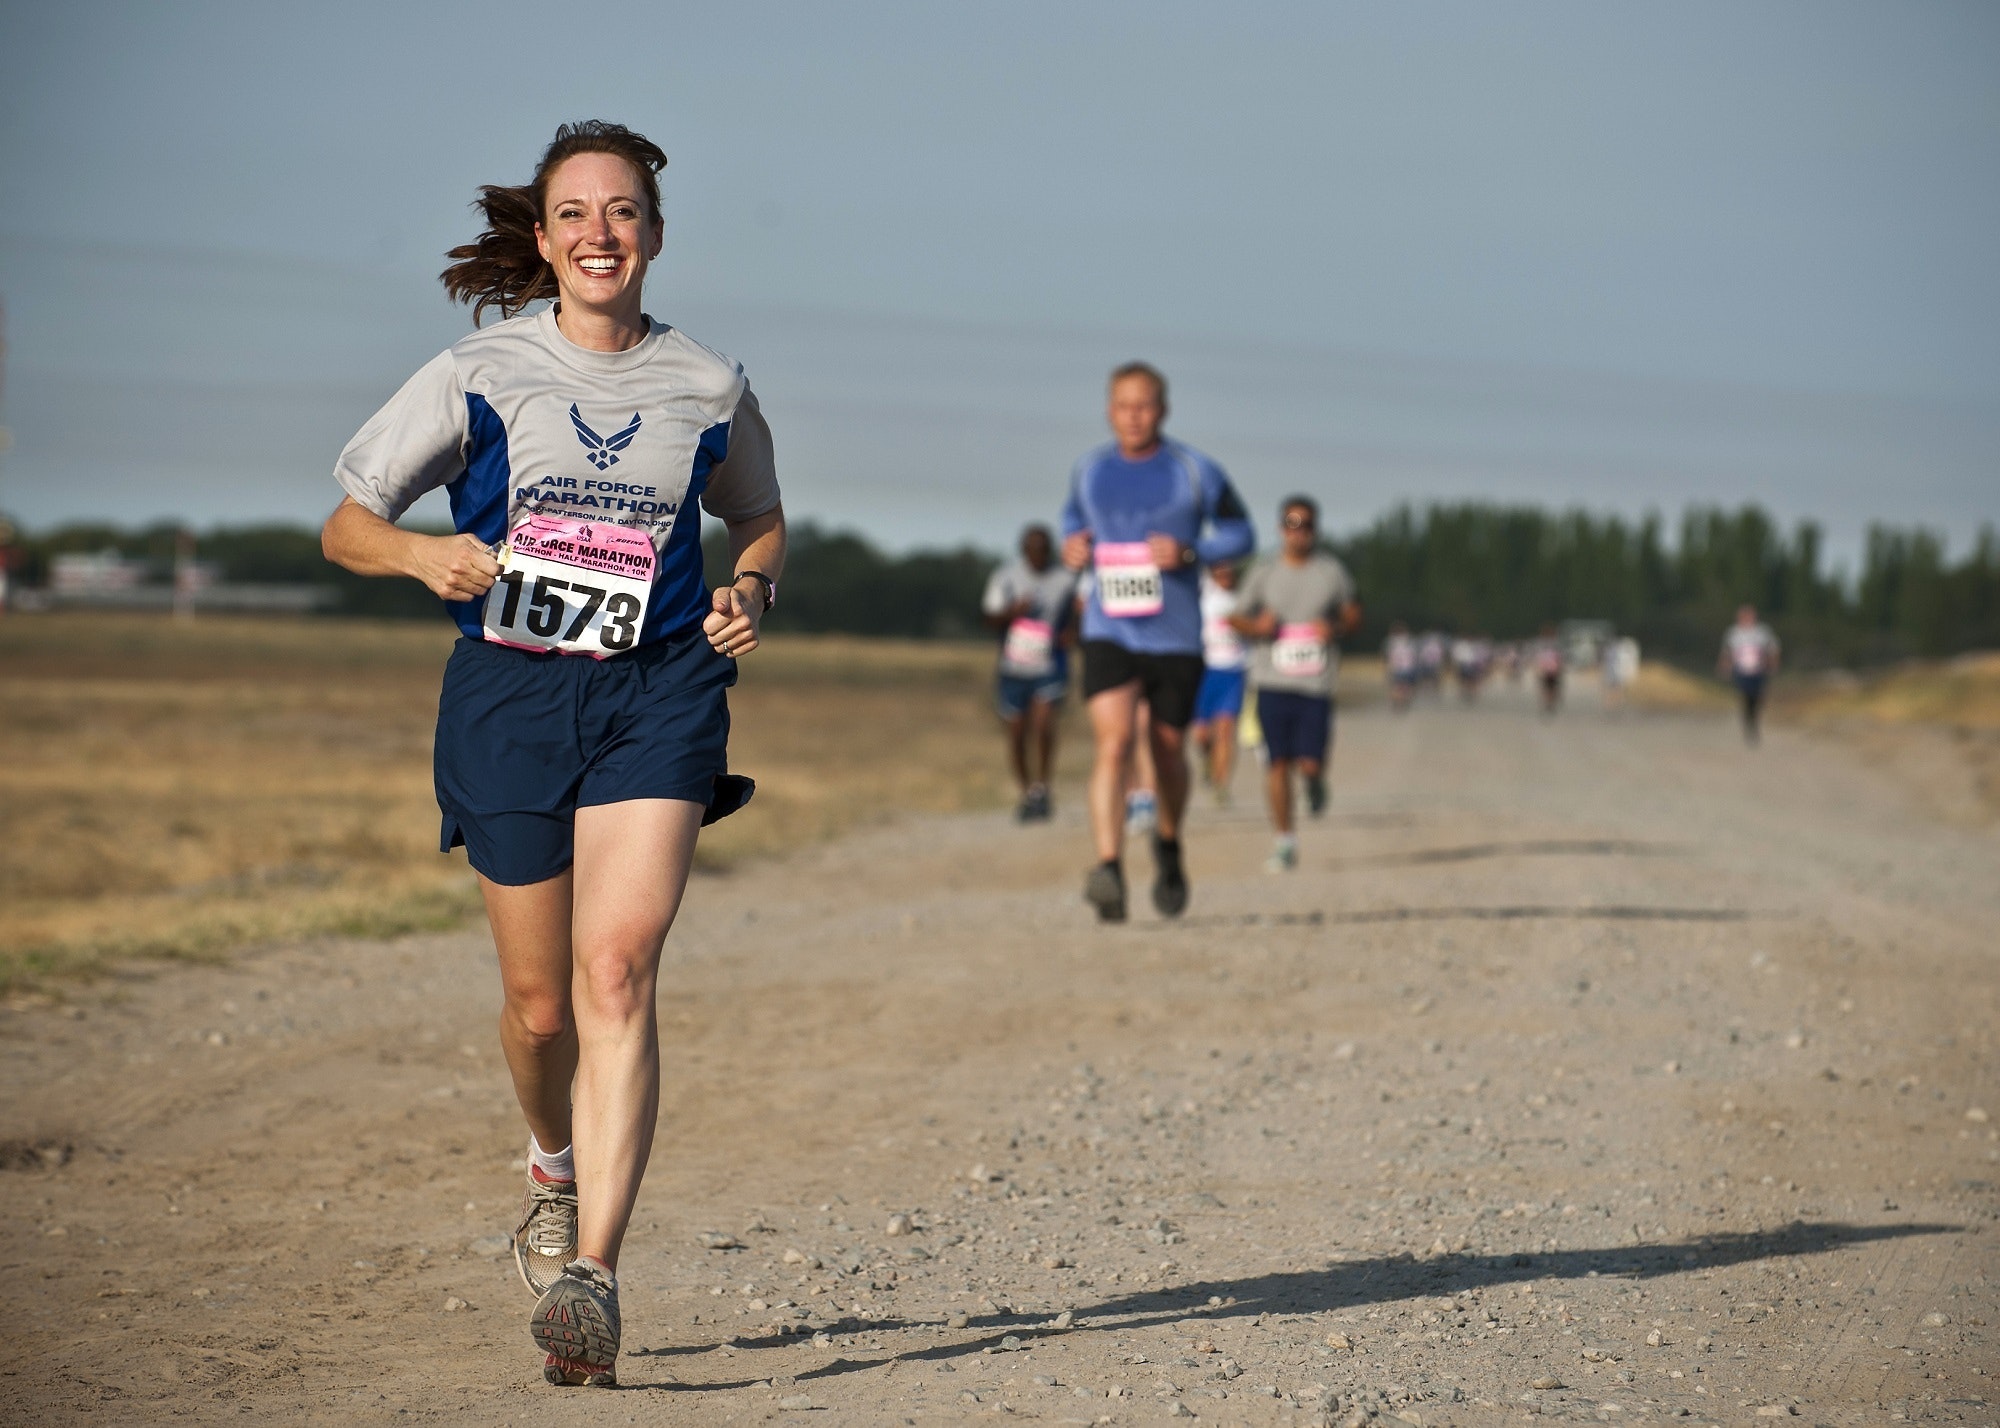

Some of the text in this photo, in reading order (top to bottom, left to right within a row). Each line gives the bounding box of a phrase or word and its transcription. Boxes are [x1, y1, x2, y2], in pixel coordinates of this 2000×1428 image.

[516, 487, 677, 515] MARATHON
[540, 476, 656, 497] AIR FORCE
[652, 519, 672, 527] OHIO
[513, 545, 552, 557] ATHON
[559, 553, 579, 562] HALF
[581, 556, 625, 572] MARATHON
[632, 568, 647, 576] 10K
[514, 533, 652, 569] AIR ORCE MARATHON
[500, 569, 641, 650] 1573
